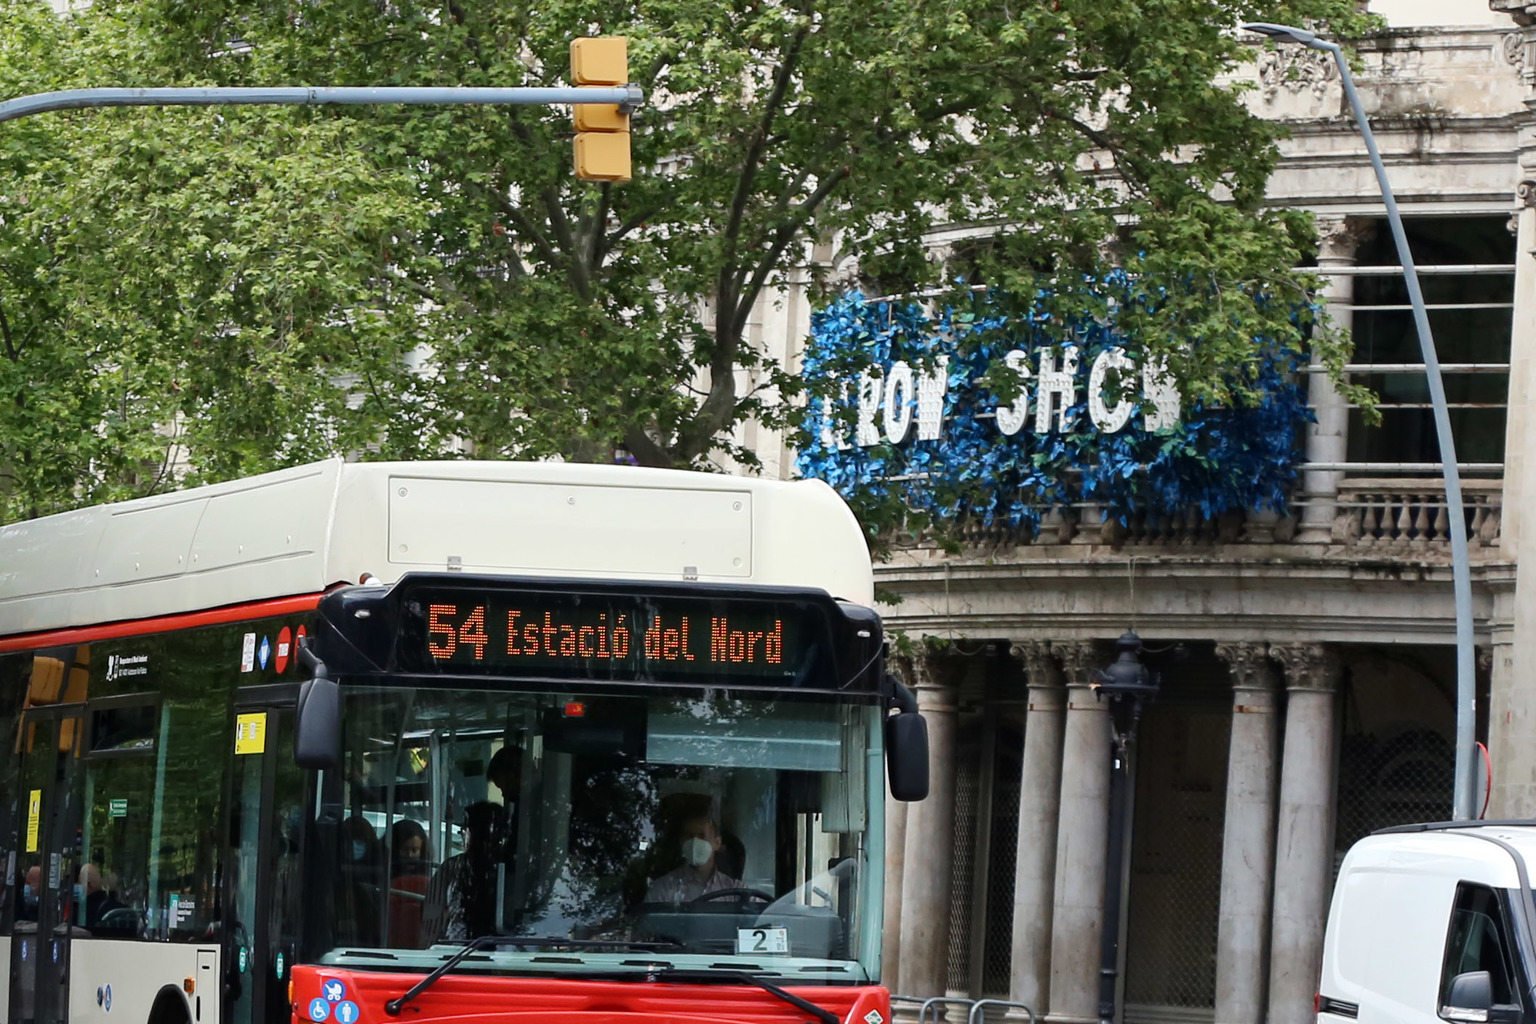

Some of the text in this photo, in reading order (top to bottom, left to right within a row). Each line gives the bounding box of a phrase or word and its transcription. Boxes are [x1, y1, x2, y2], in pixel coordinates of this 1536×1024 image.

[429, 604, 782, 664] 54 Estació del Nord
[753, 930, 767, 951] 2
